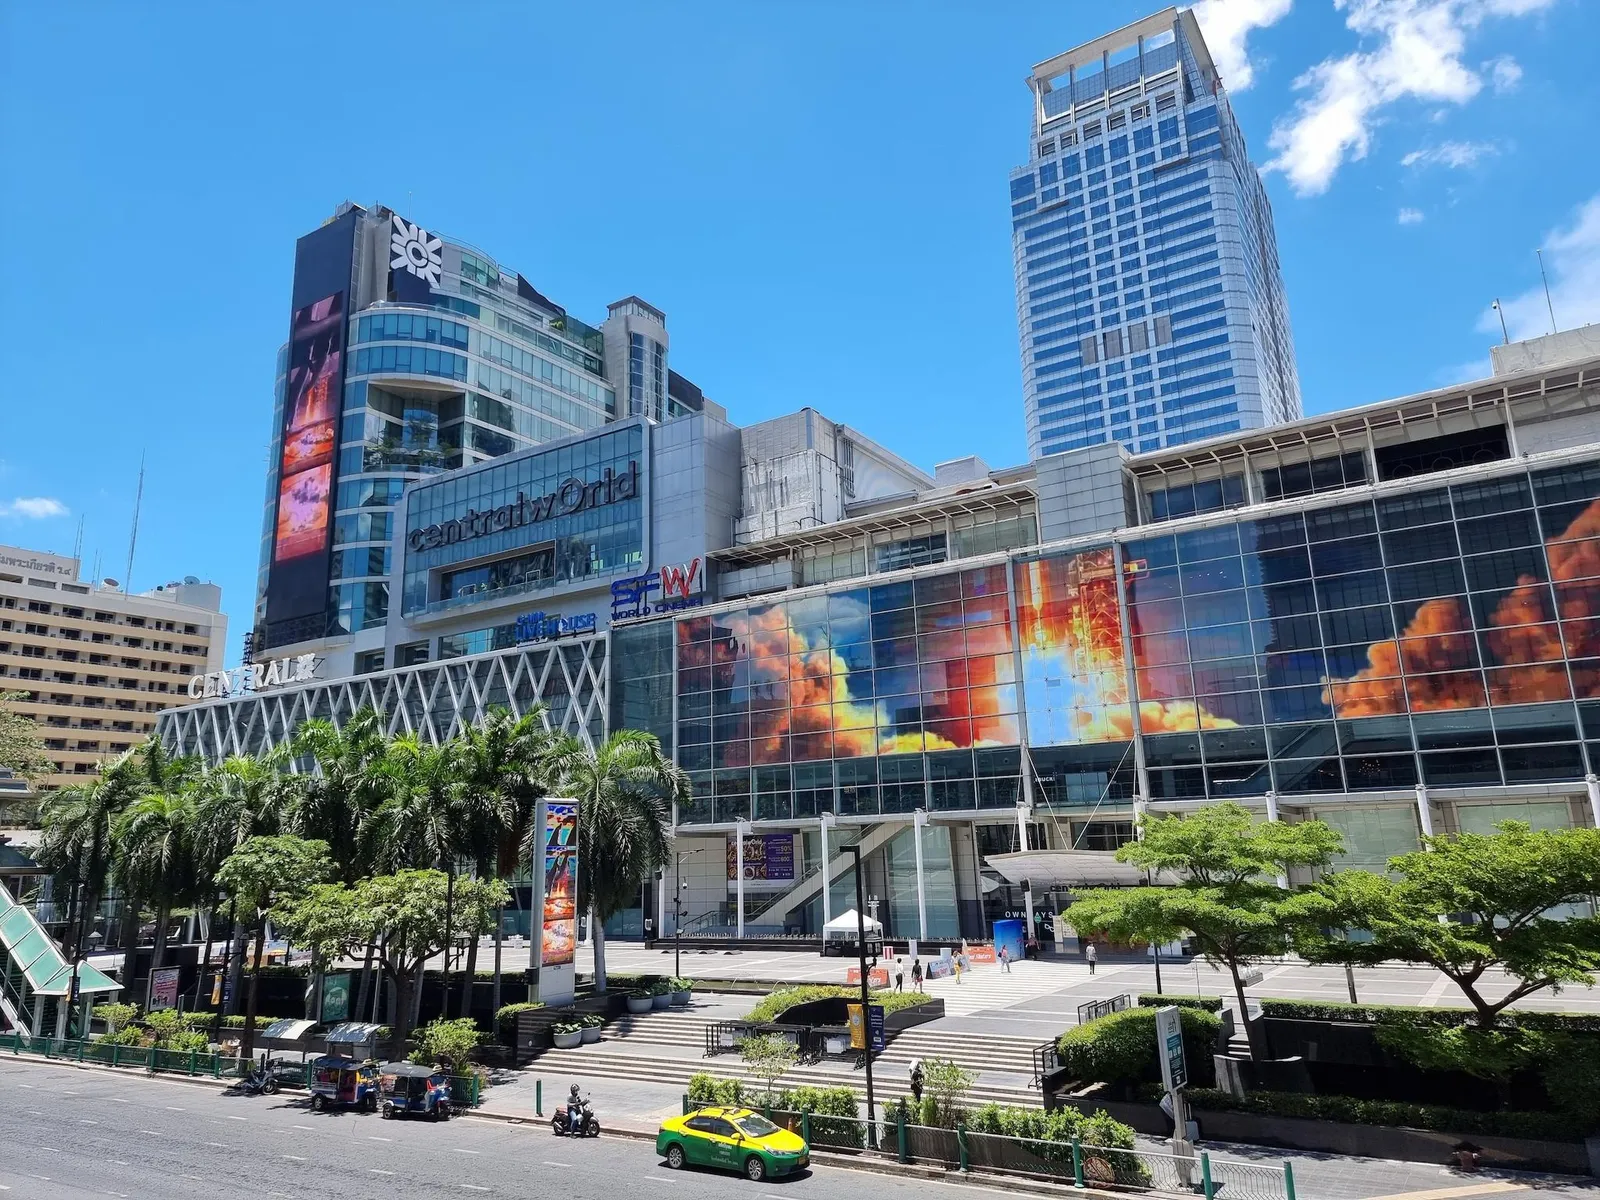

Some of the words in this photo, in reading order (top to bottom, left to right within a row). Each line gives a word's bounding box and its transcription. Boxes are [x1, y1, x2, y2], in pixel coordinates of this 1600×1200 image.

[408, 460, 636, 552] centralwOrld
[611, 606, 651, 621] WORLD
[655, 597, 704, 613] CINEMA
[515, 618, 545, 642] LIVE
[187, 657, 296, 700] CENTRAL
[1005, 911, 1054, 919] OWNAYS
